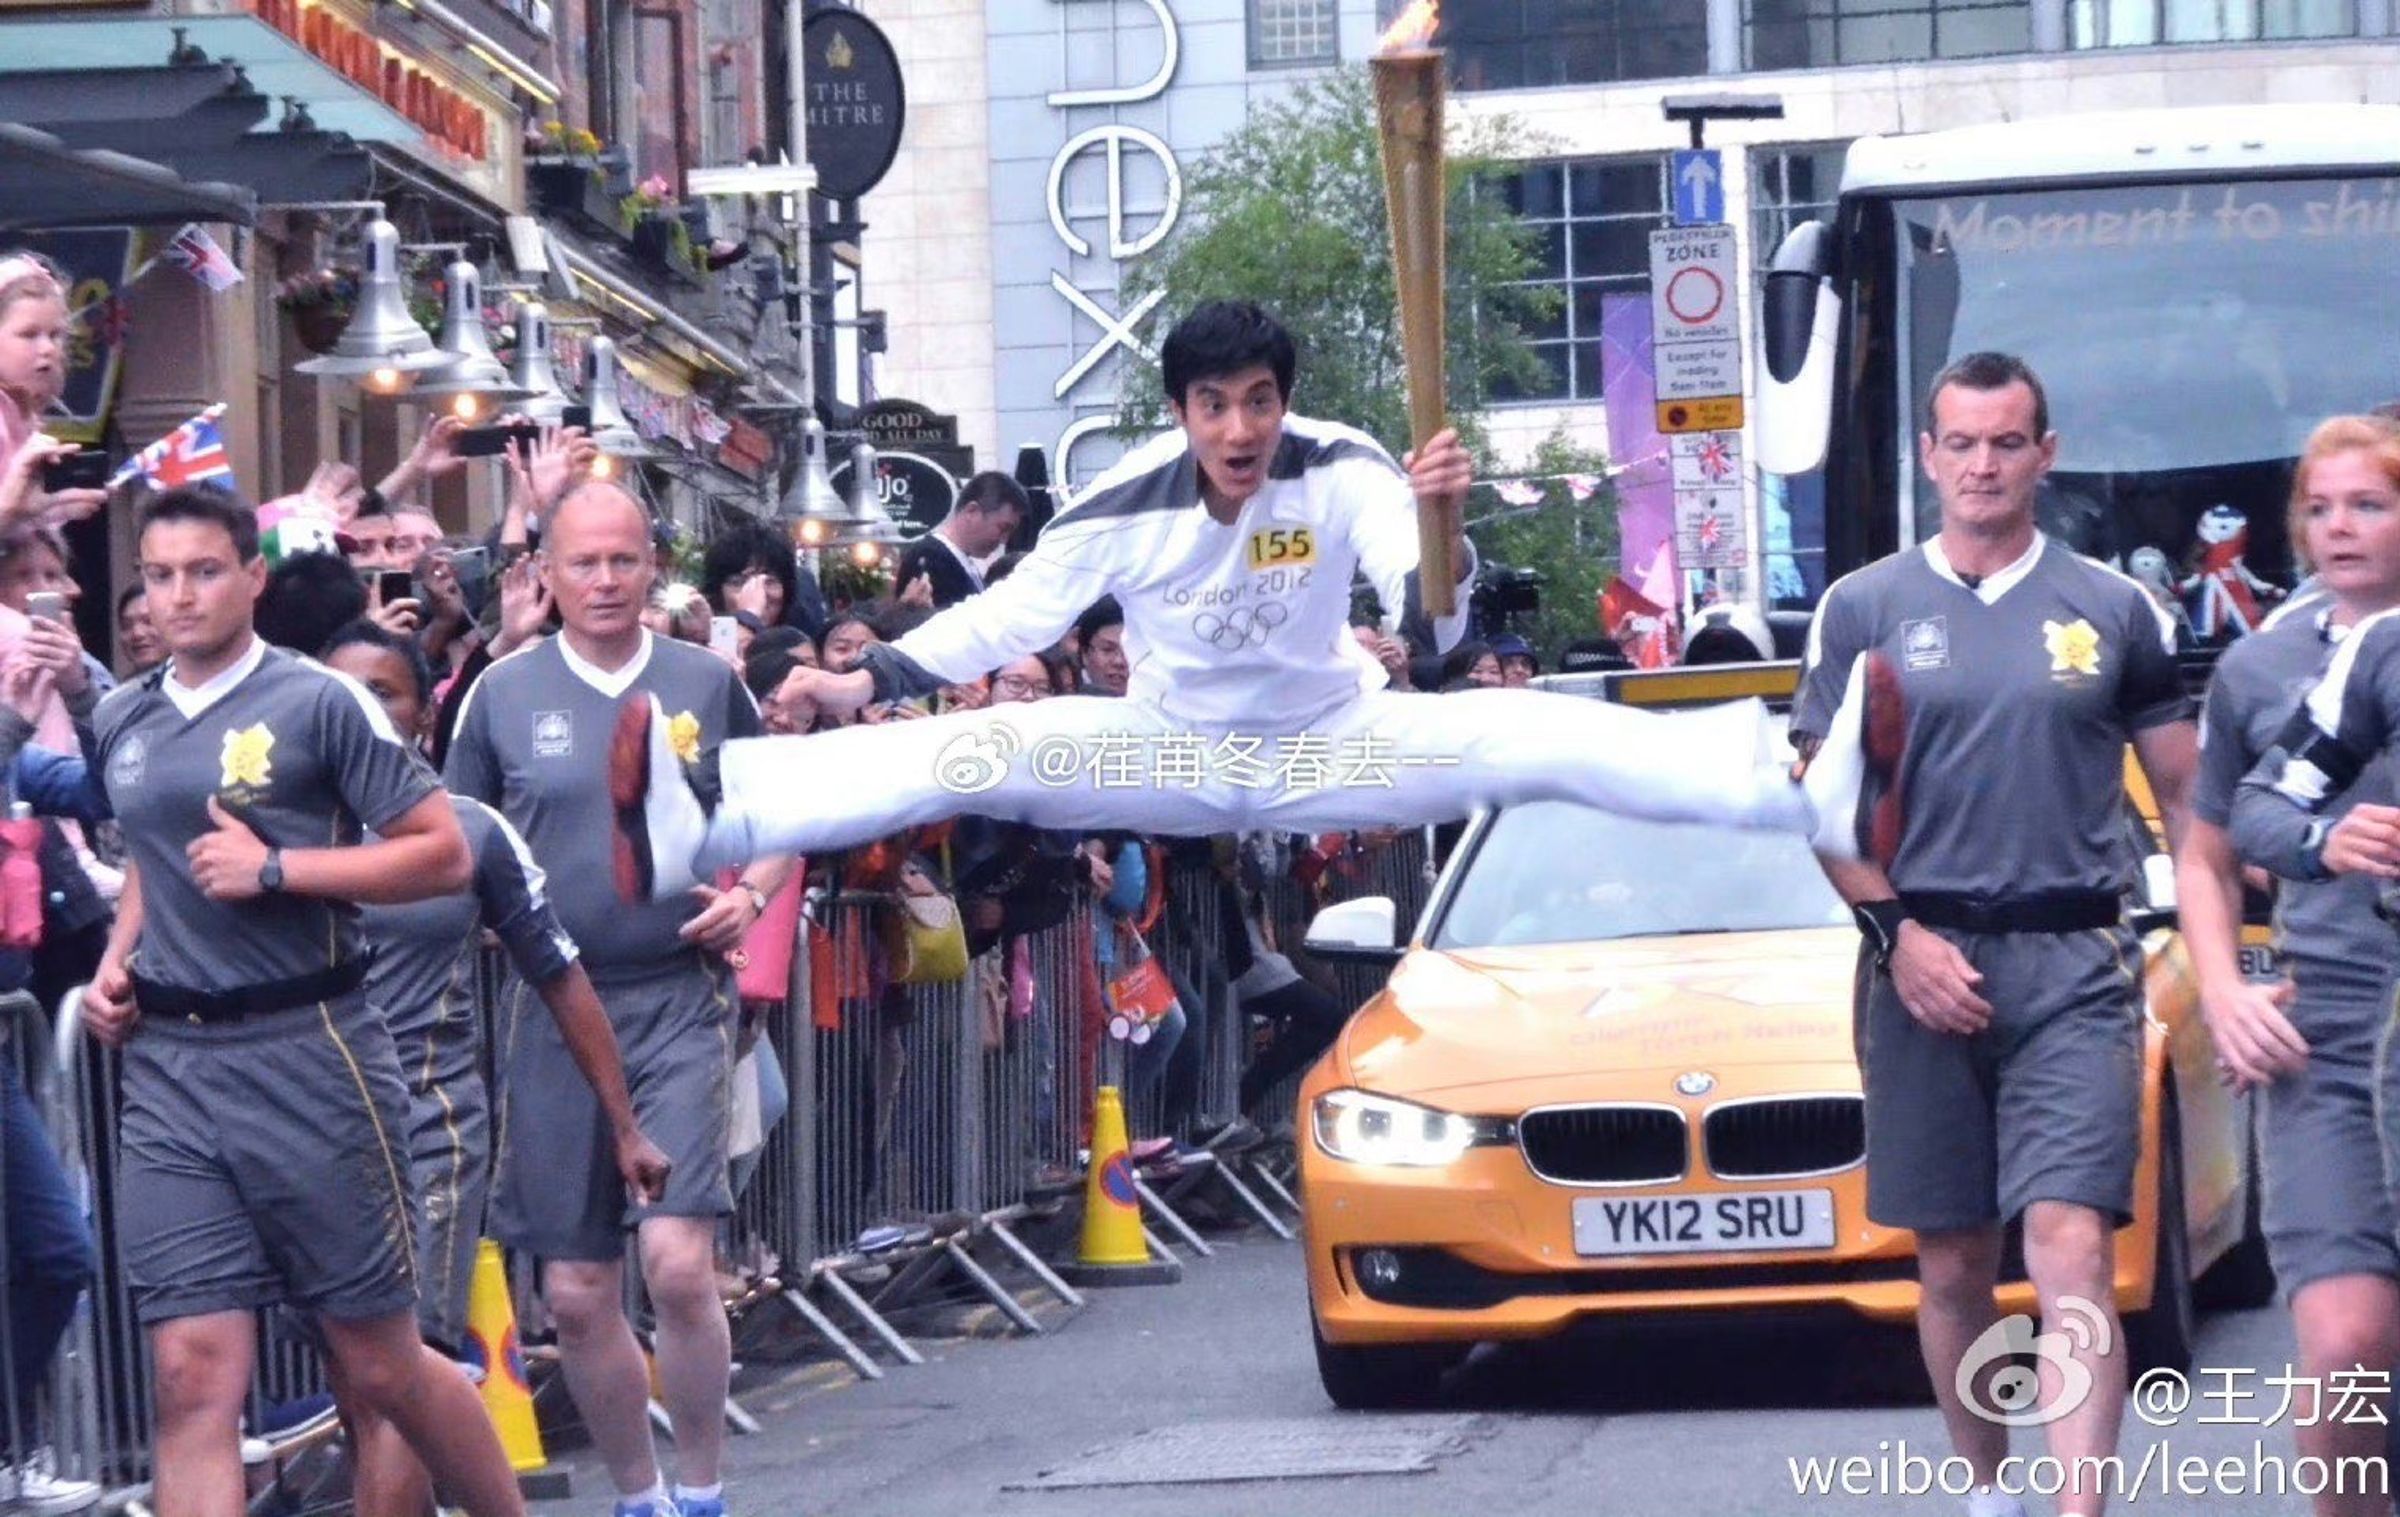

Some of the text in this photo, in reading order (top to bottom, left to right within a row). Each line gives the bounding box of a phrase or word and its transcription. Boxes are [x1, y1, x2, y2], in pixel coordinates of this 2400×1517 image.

[812, 82, 868, 102] THE
[1932, 179, 2400, 253] Moment to shi
[1666, 243, 1720, 262] ZONE
[862, 412, 923, 428] GOOD
[1253, 529, 1311, 562] 155
[1162, 566, 1313, 606] London 2012
[1603, 1195, 1804, 1243] YK12 SRU
